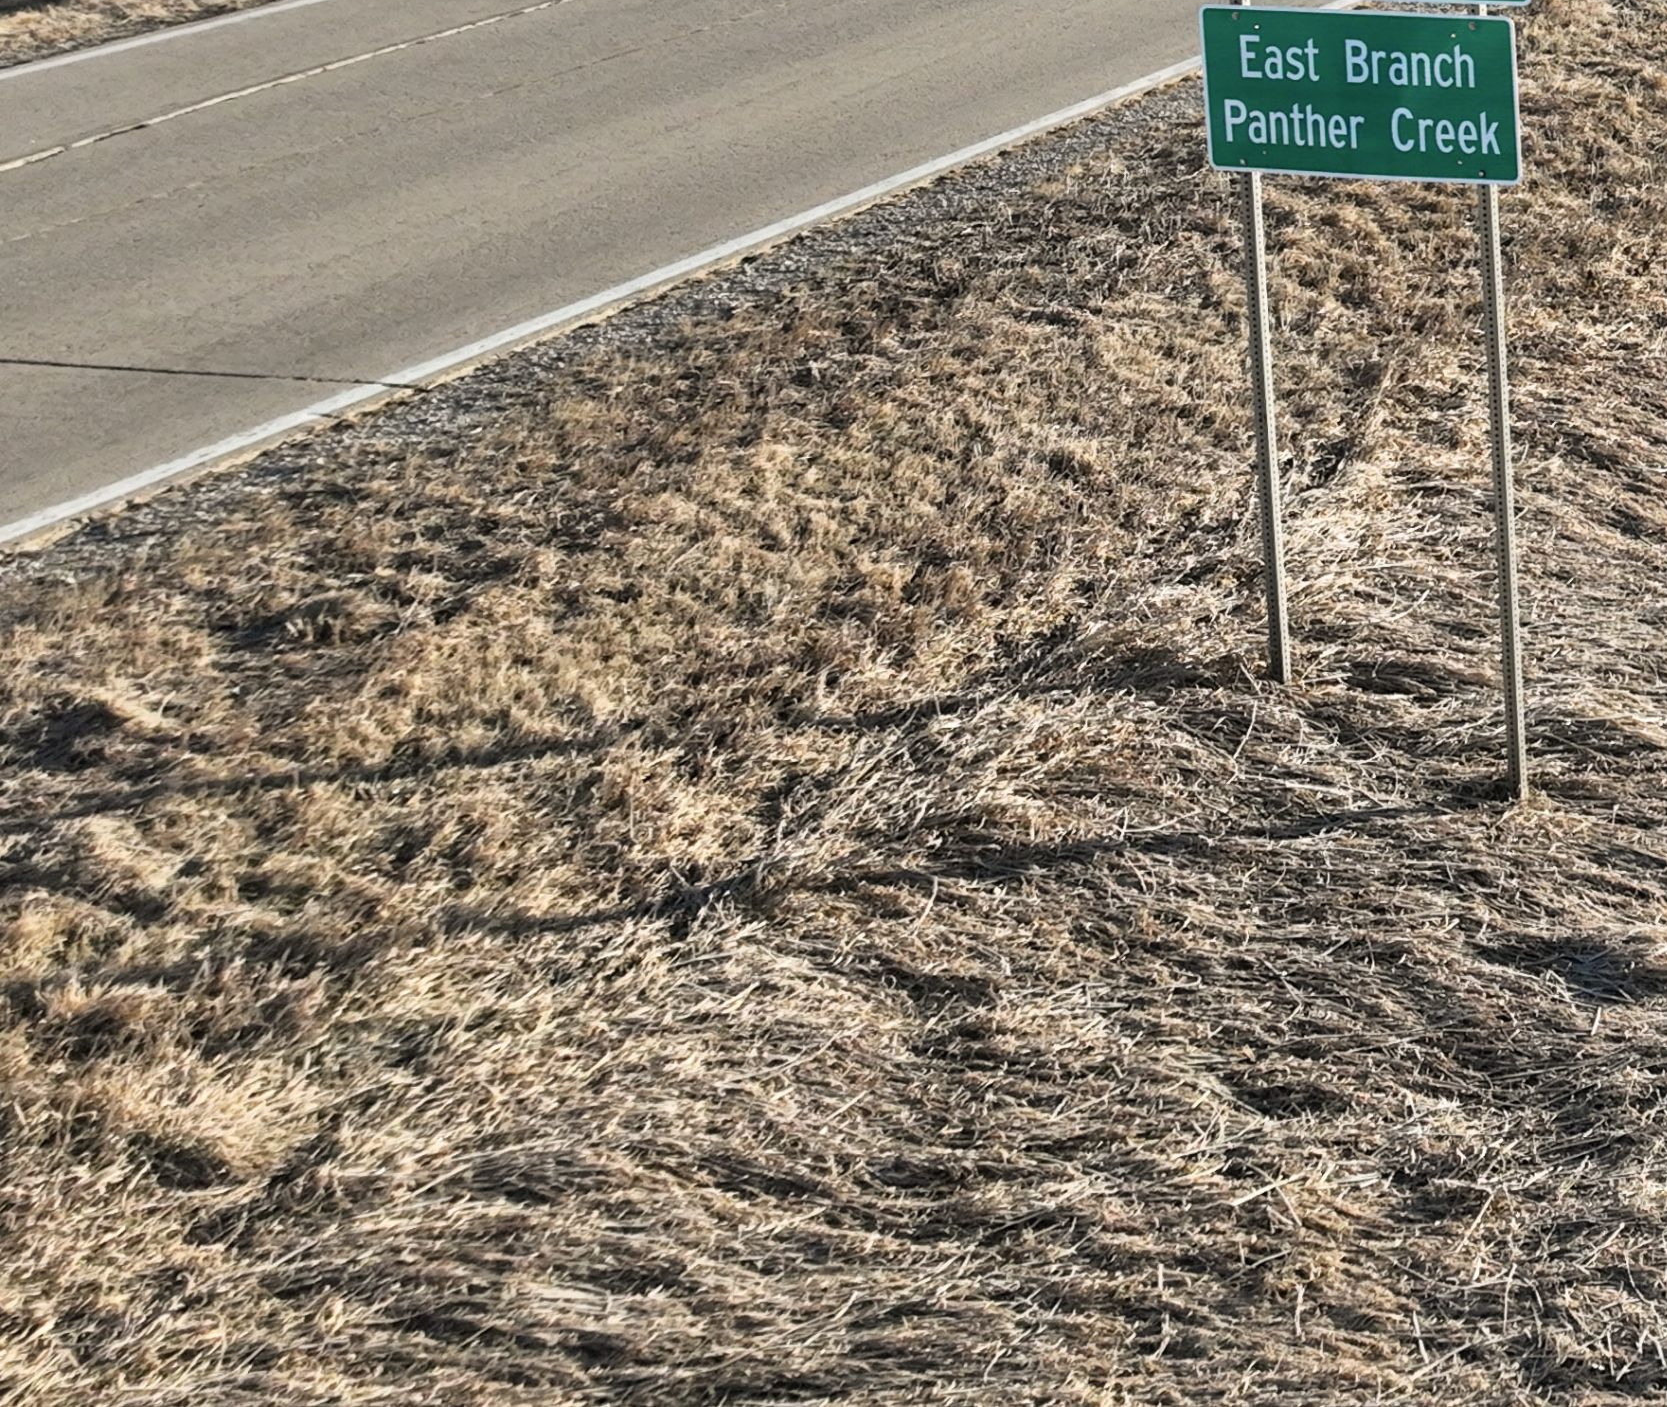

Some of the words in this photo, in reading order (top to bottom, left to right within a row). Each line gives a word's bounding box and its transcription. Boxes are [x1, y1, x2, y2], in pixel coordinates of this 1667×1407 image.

[1239, 34, 1320, 82] East
[1345, 39, 1475, 88] Branch
[1224, 98, 1364, 149] Panther
[1391, 107, 1501, 155] Creek
